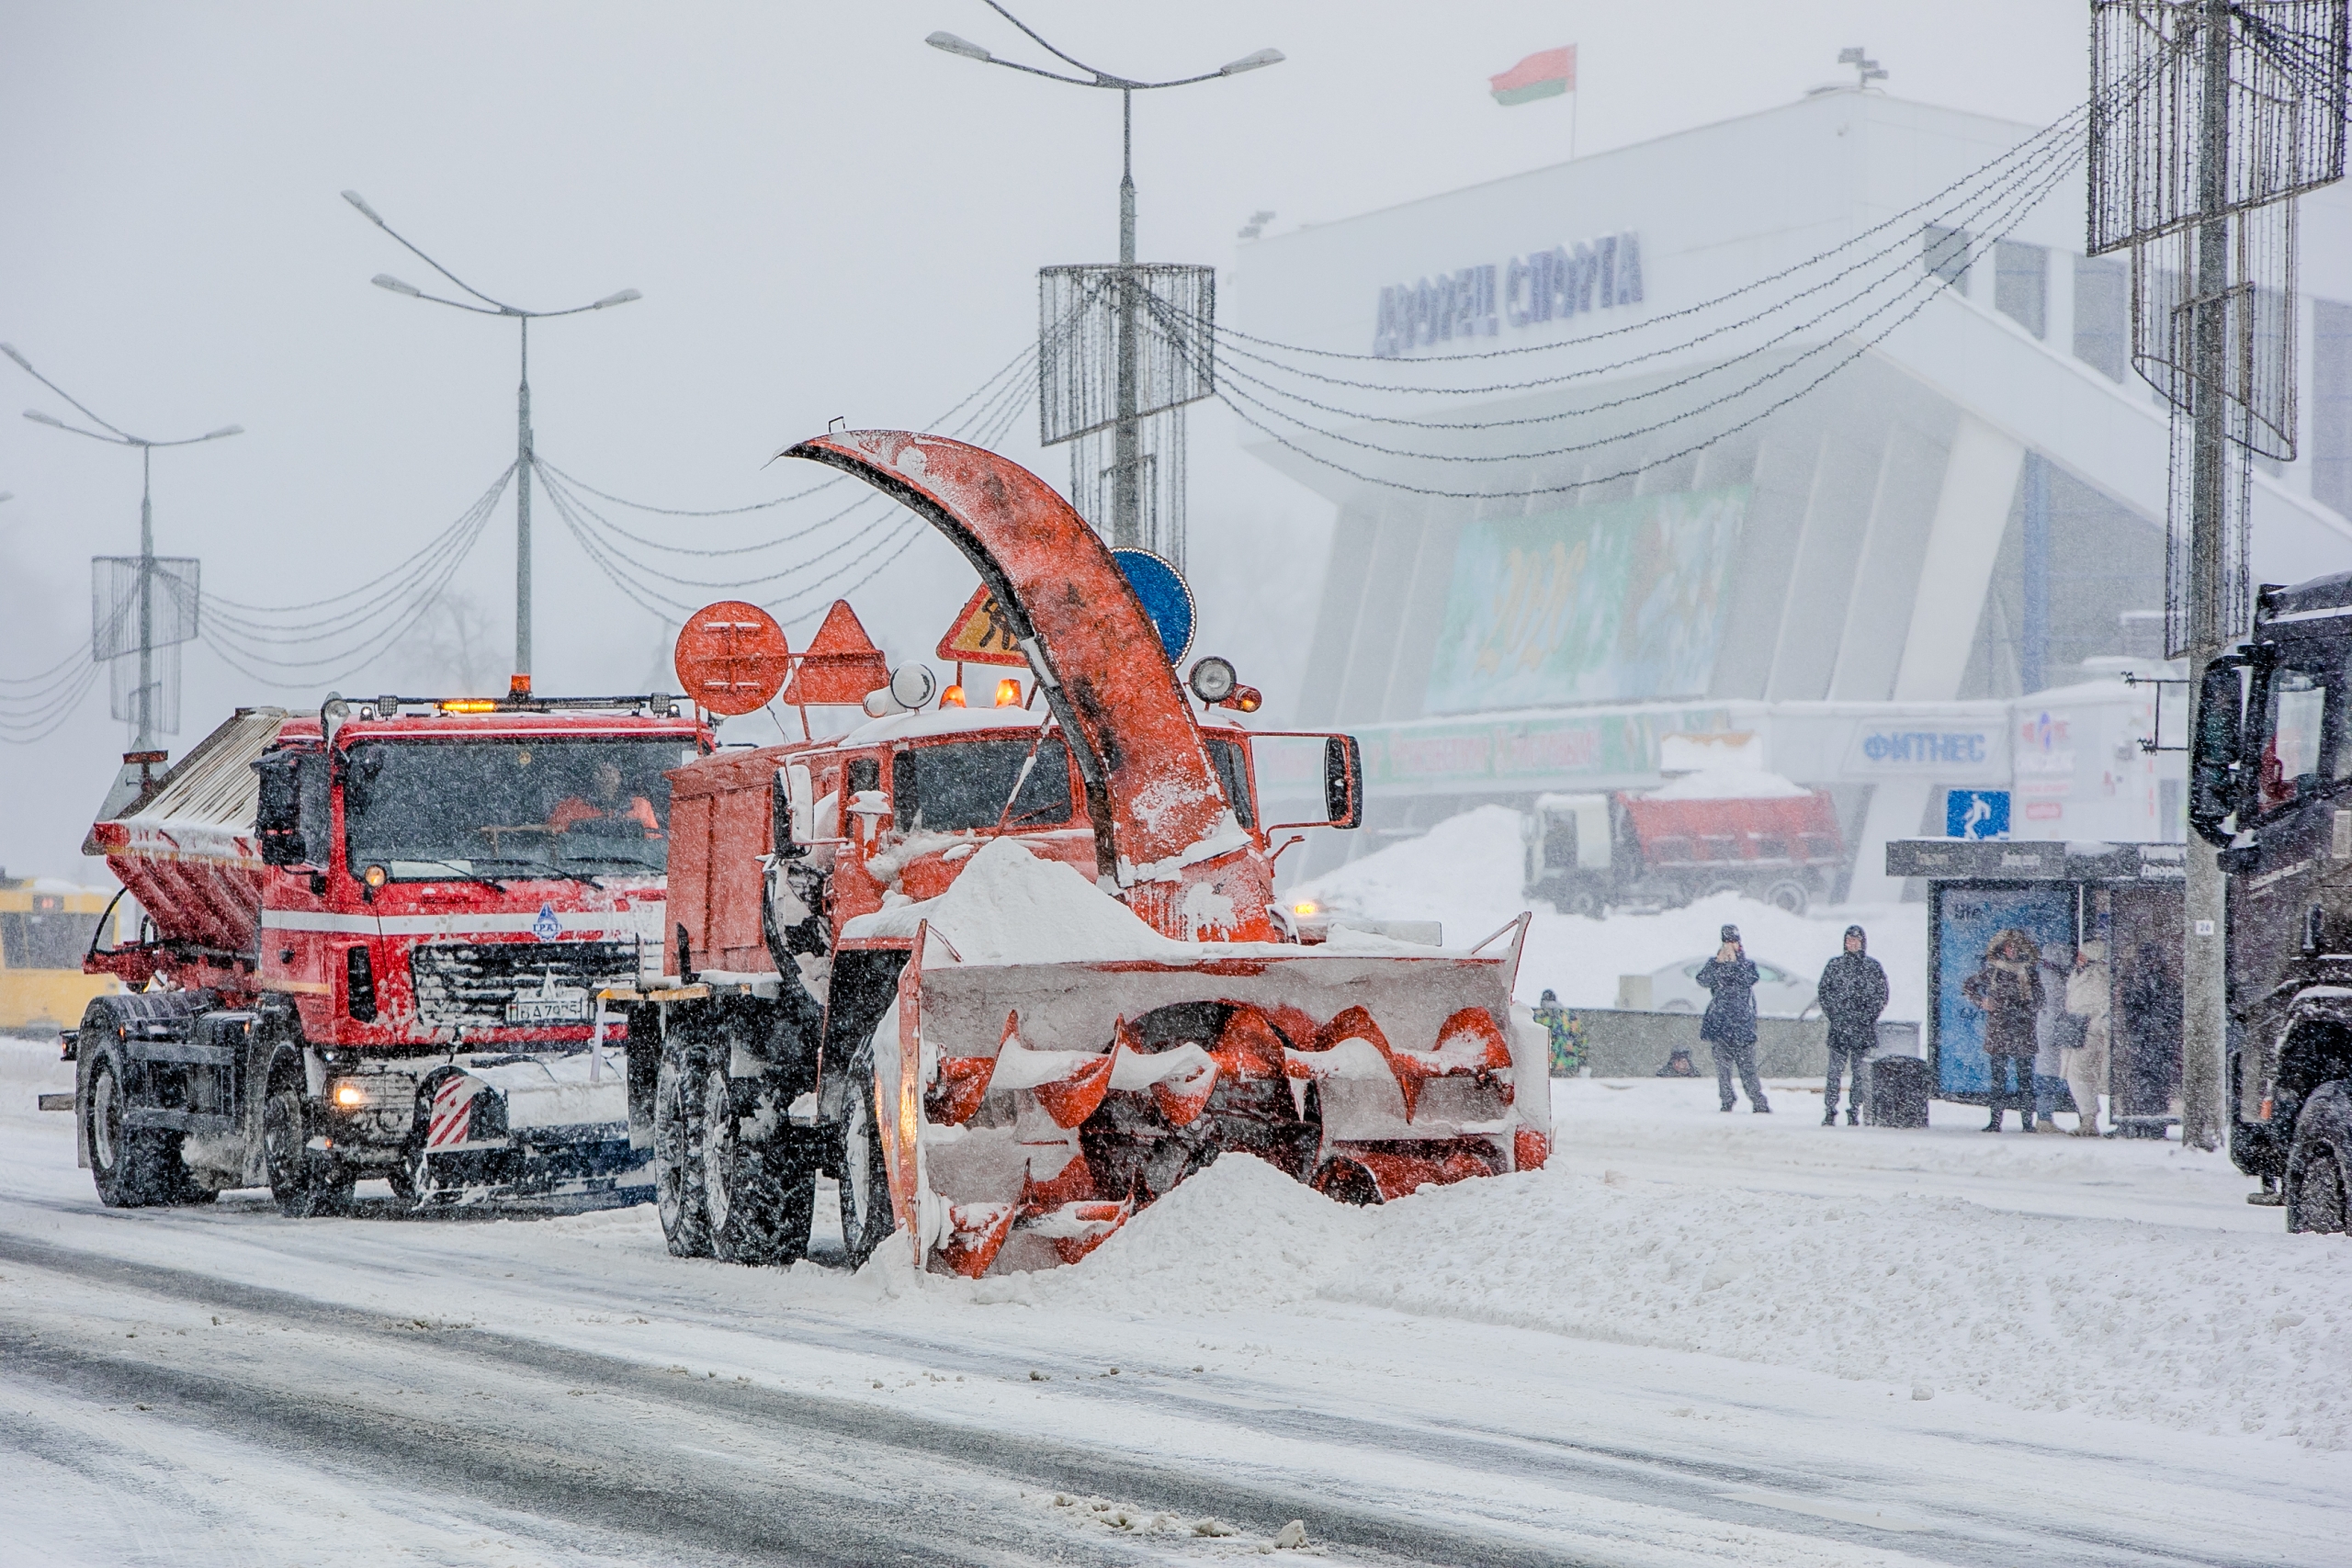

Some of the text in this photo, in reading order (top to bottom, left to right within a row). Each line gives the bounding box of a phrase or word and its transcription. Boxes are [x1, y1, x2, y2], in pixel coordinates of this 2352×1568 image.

[1374, 230, 1643, 357] ДВОРЕЦ СПОРТА
[1862, 732, 1986, 762] ФИТНЕС
